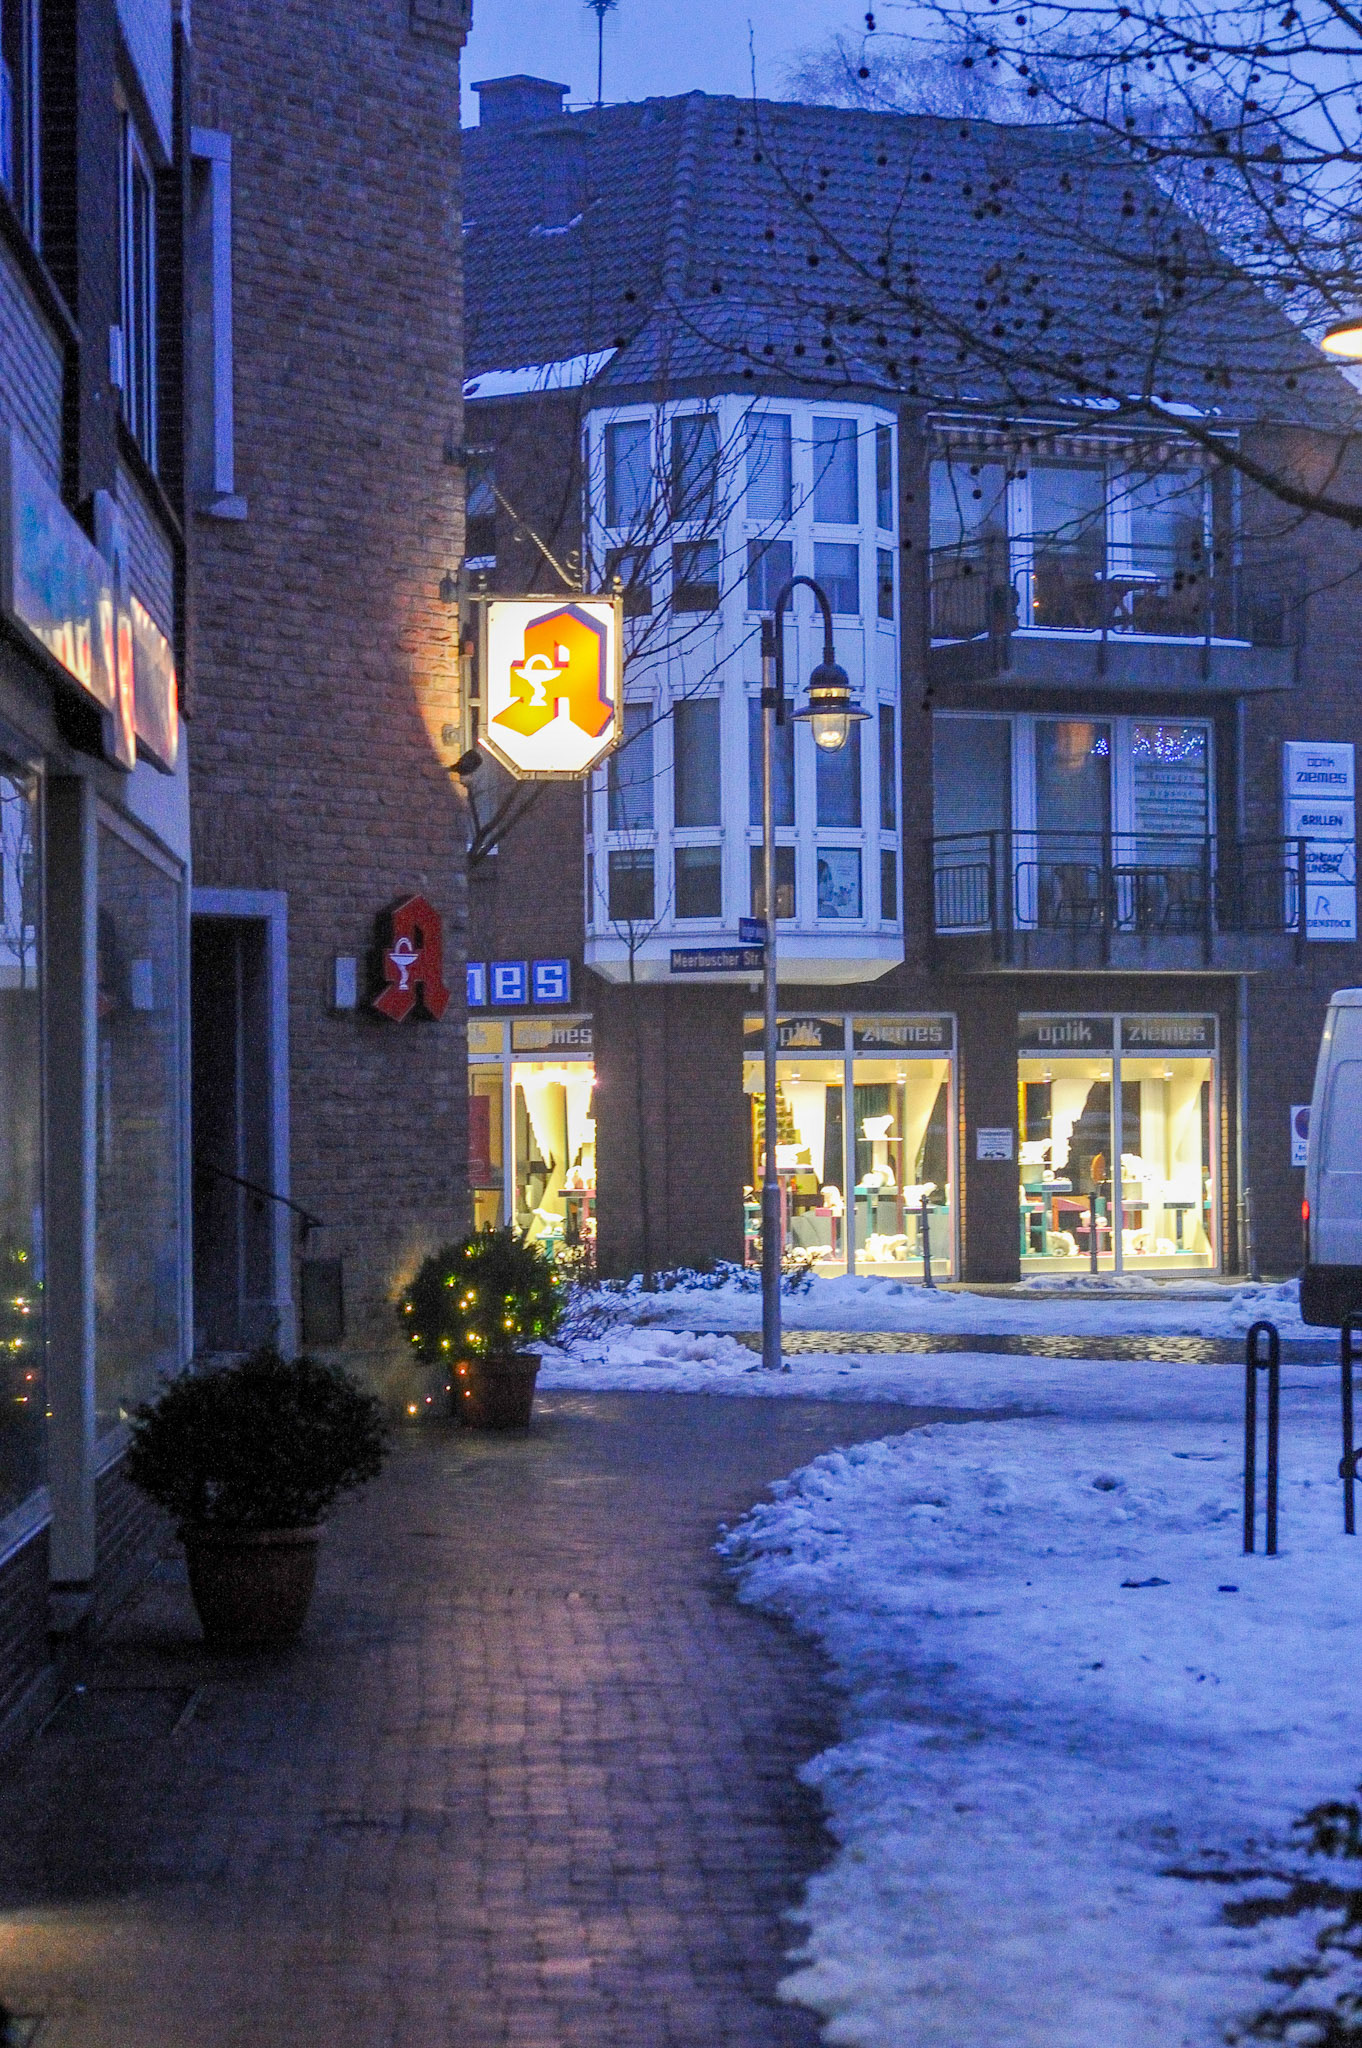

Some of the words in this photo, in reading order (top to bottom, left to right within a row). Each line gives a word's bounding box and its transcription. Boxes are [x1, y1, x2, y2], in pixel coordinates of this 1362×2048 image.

[1301, 814, 1343, 826] BRILLEN
[672, 951, 740, 969] Meerbuscher
[1037, 1020, 1093, 1045] optik
[1127, 1021, 1207, 1042] ziemes
